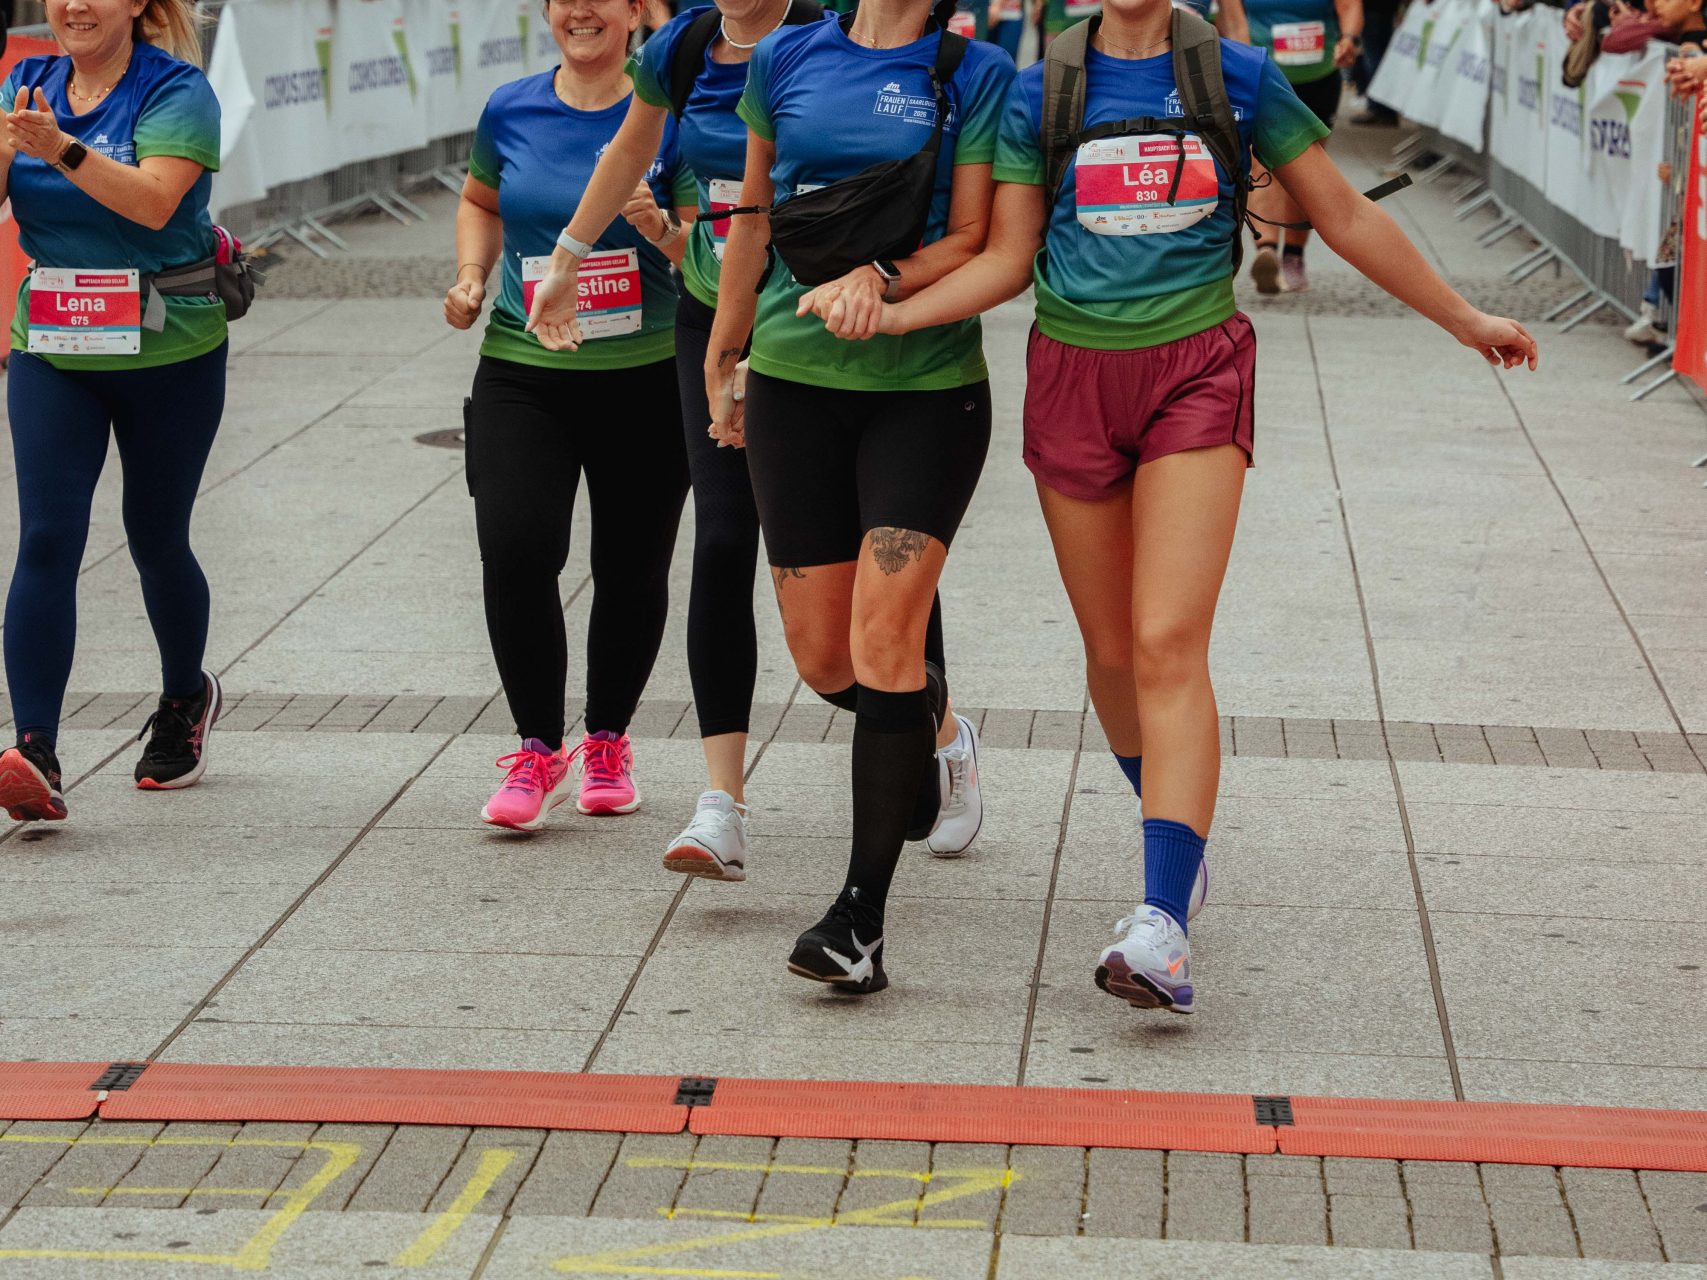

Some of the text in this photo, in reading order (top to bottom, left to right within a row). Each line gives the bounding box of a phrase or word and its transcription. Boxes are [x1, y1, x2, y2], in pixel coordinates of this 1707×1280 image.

[880, 95, 906, 105] FRAUEN
[877, 103, 904, 114] LAUF
[1122, 164, 1169, 186] Léa
[1136, 191, 1158, 202] 830
[577, 276, 630, 297] stine
[56, 292, 105, 312] Lena
[70, 315, 89, 326] 675
